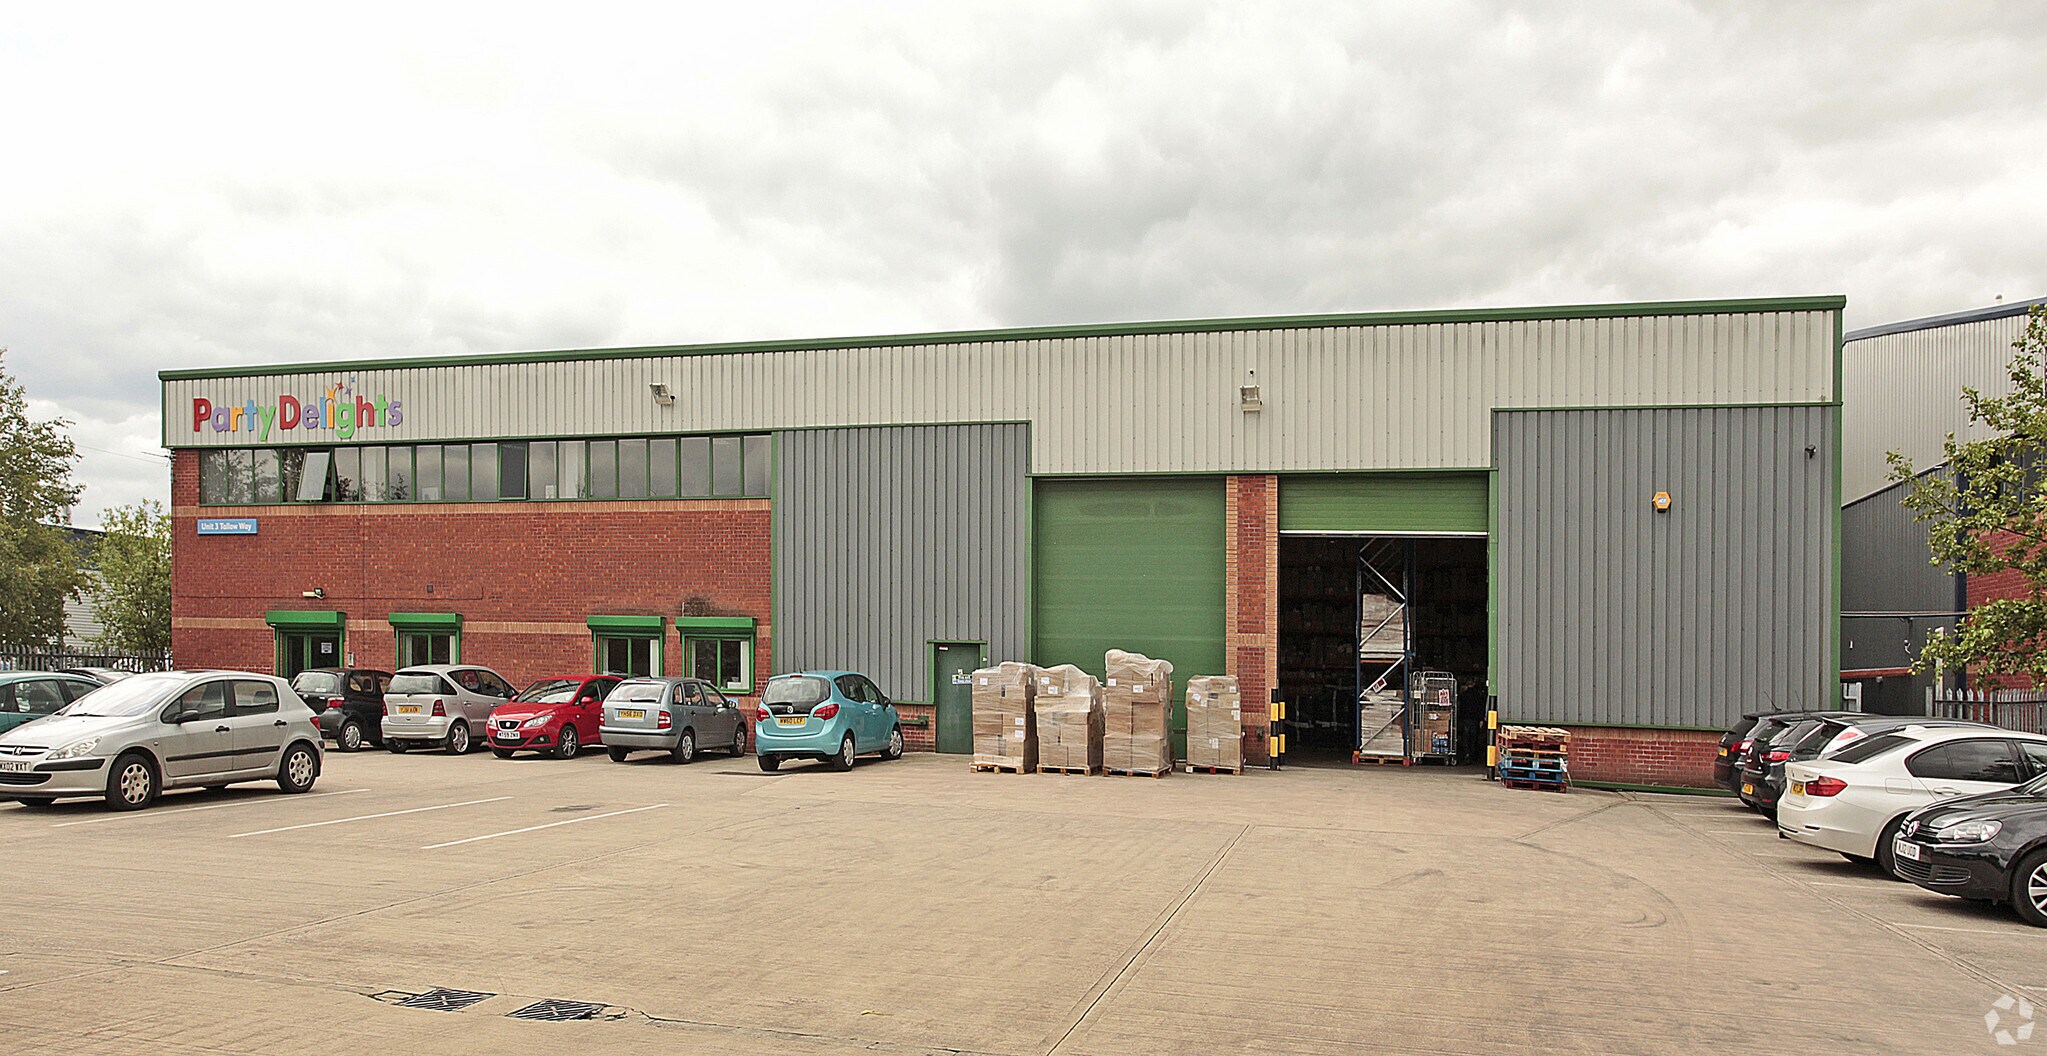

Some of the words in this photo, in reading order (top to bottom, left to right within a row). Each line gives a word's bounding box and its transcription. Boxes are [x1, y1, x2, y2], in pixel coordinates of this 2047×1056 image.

[193, 397, 276, 441] Party
[278, 394, 403, 439] Delights
[201, 522, 214, 530] Unit
[220, 522, 237, 530] Tallow
[238, 522, 252, 532] Way
